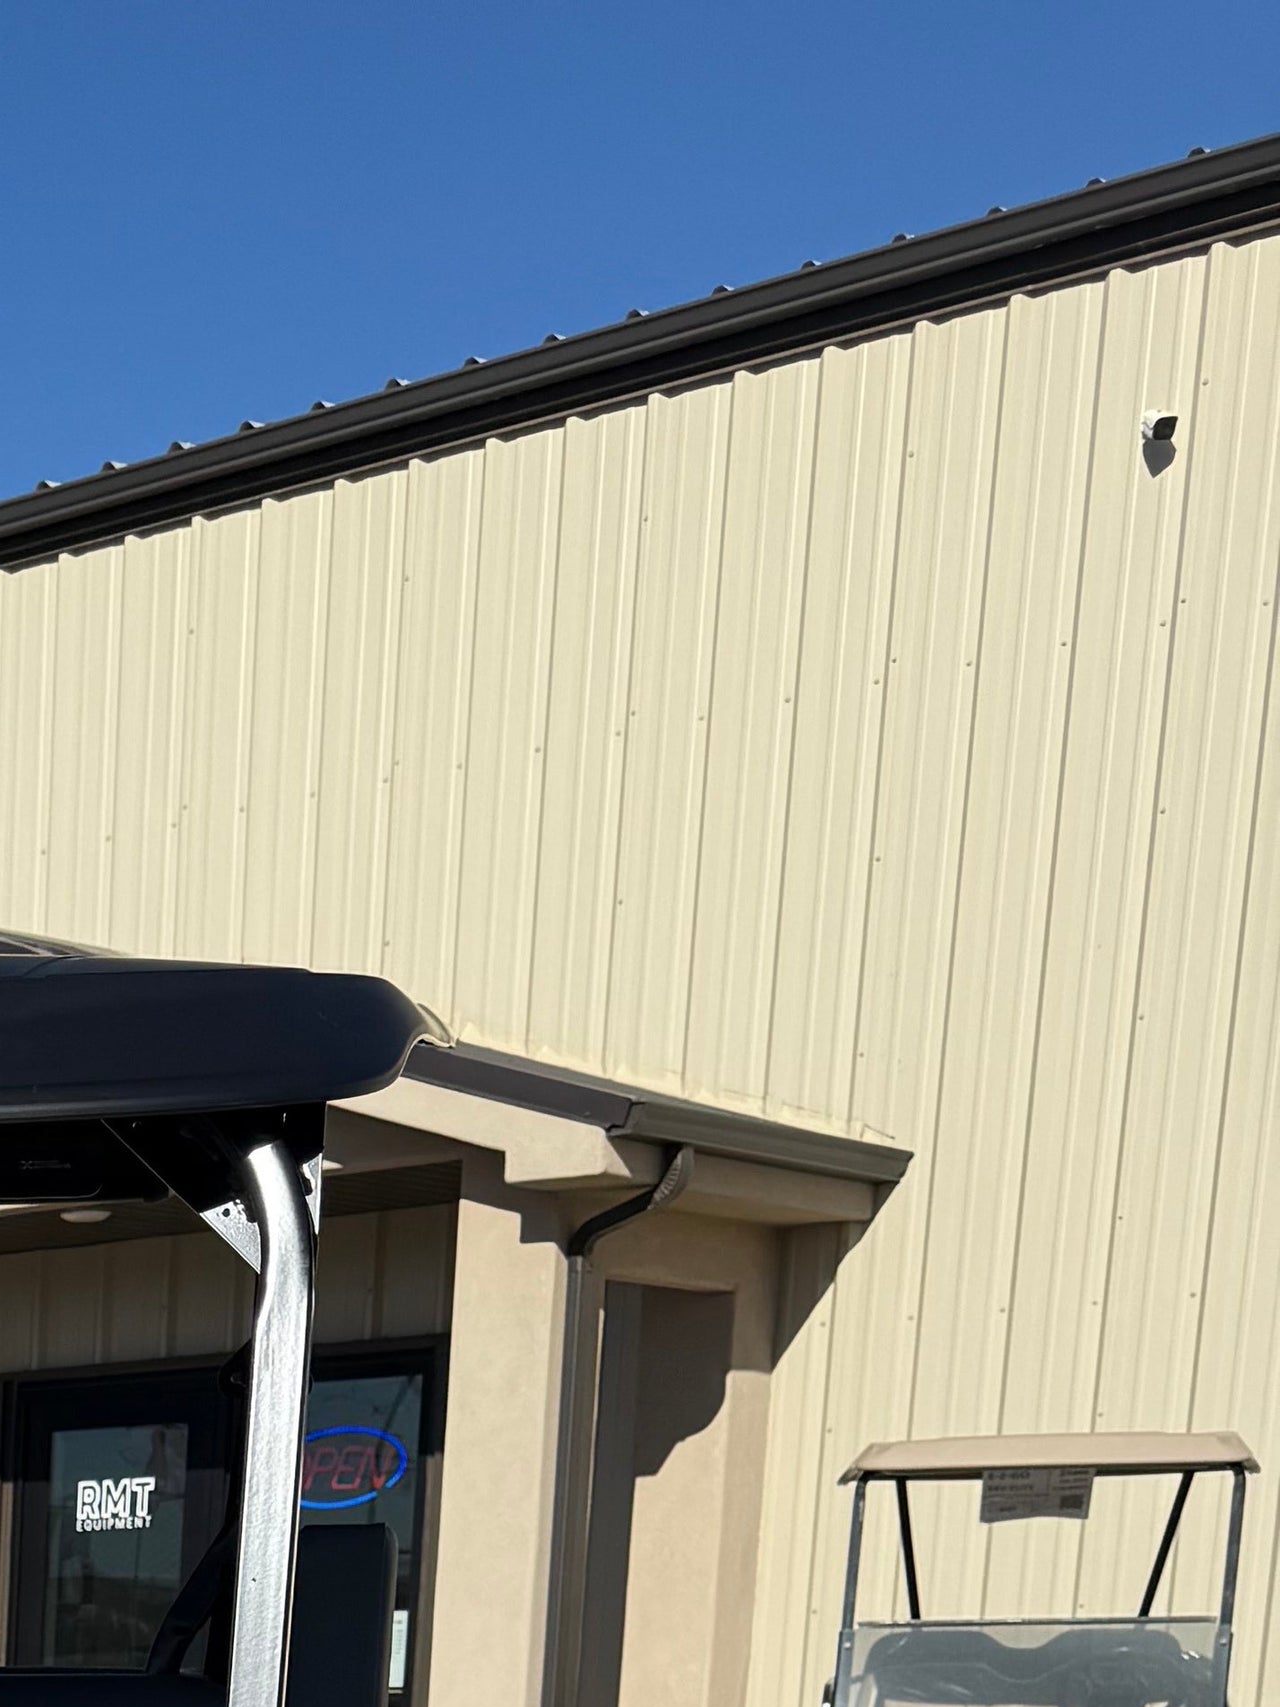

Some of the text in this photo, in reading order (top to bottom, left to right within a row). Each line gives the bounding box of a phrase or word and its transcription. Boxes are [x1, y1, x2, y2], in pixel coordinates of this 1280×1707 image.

[302, 1446, 397, 1490] PEN
[76, 1476, 155, 1519] RMT
[75, 1515, 151, 1532] EQUIPMENT
